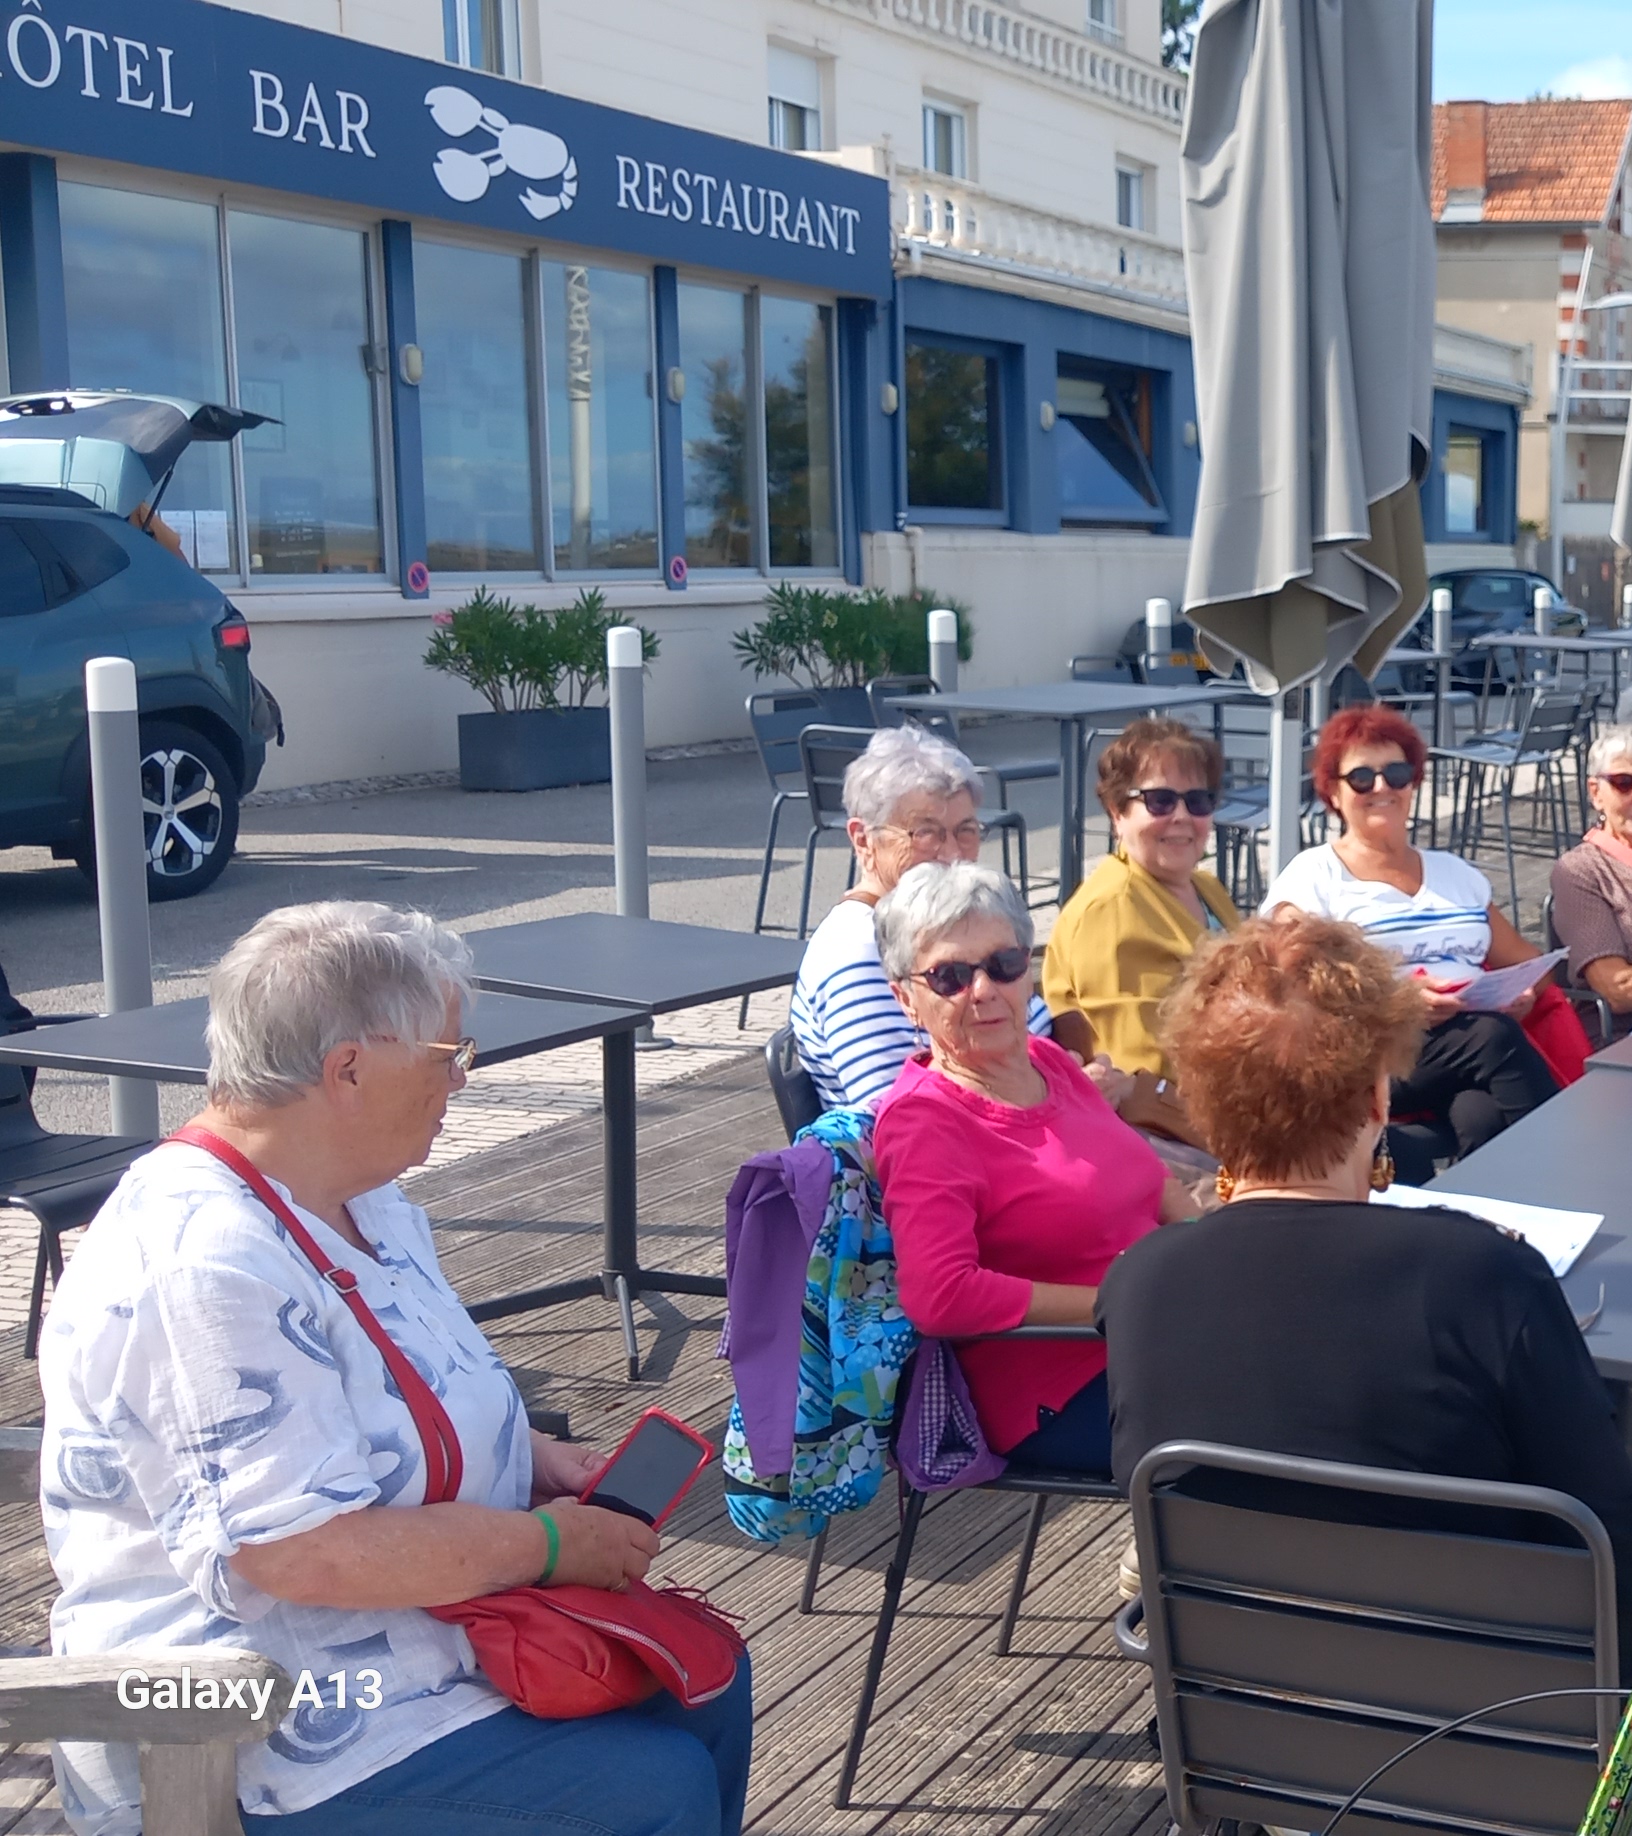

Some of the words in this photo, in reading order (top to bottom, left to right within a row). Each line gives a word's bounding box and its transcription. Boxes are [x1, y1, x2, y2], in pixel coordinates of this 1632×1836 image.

[0, 0, 194, 118] ÔTEL
[249, 69, 377, 158] BAR
[615, 154, 861, 255] RESTAURANT
